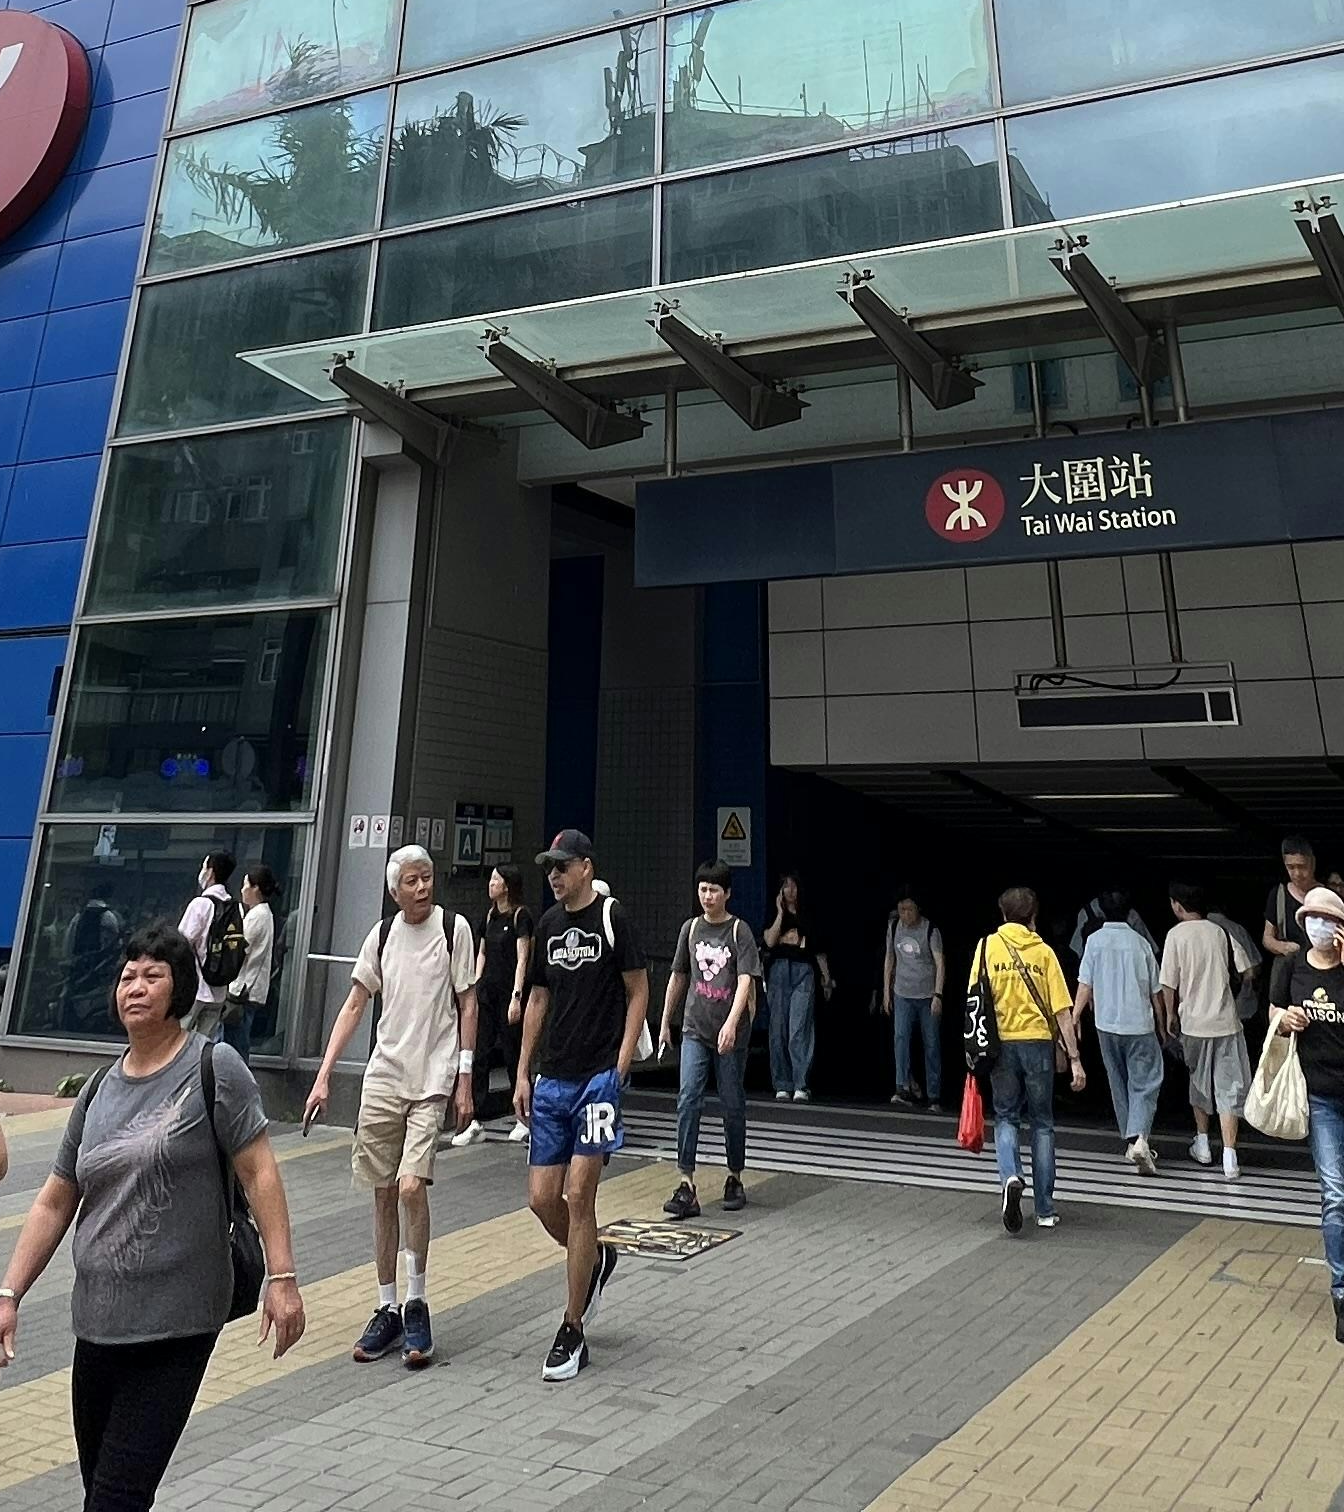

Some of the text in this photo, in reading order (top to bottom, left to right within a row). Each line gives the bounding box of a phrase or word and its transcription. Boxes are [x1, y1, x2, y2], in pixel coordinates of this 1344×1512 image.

[1019, 452, 1153, 509] 大圍站
[1020, 506, 1177, 536] Tai Wai Station
[462, 833, 472, 856] A
[579, 1101, 617, 1145] JR
